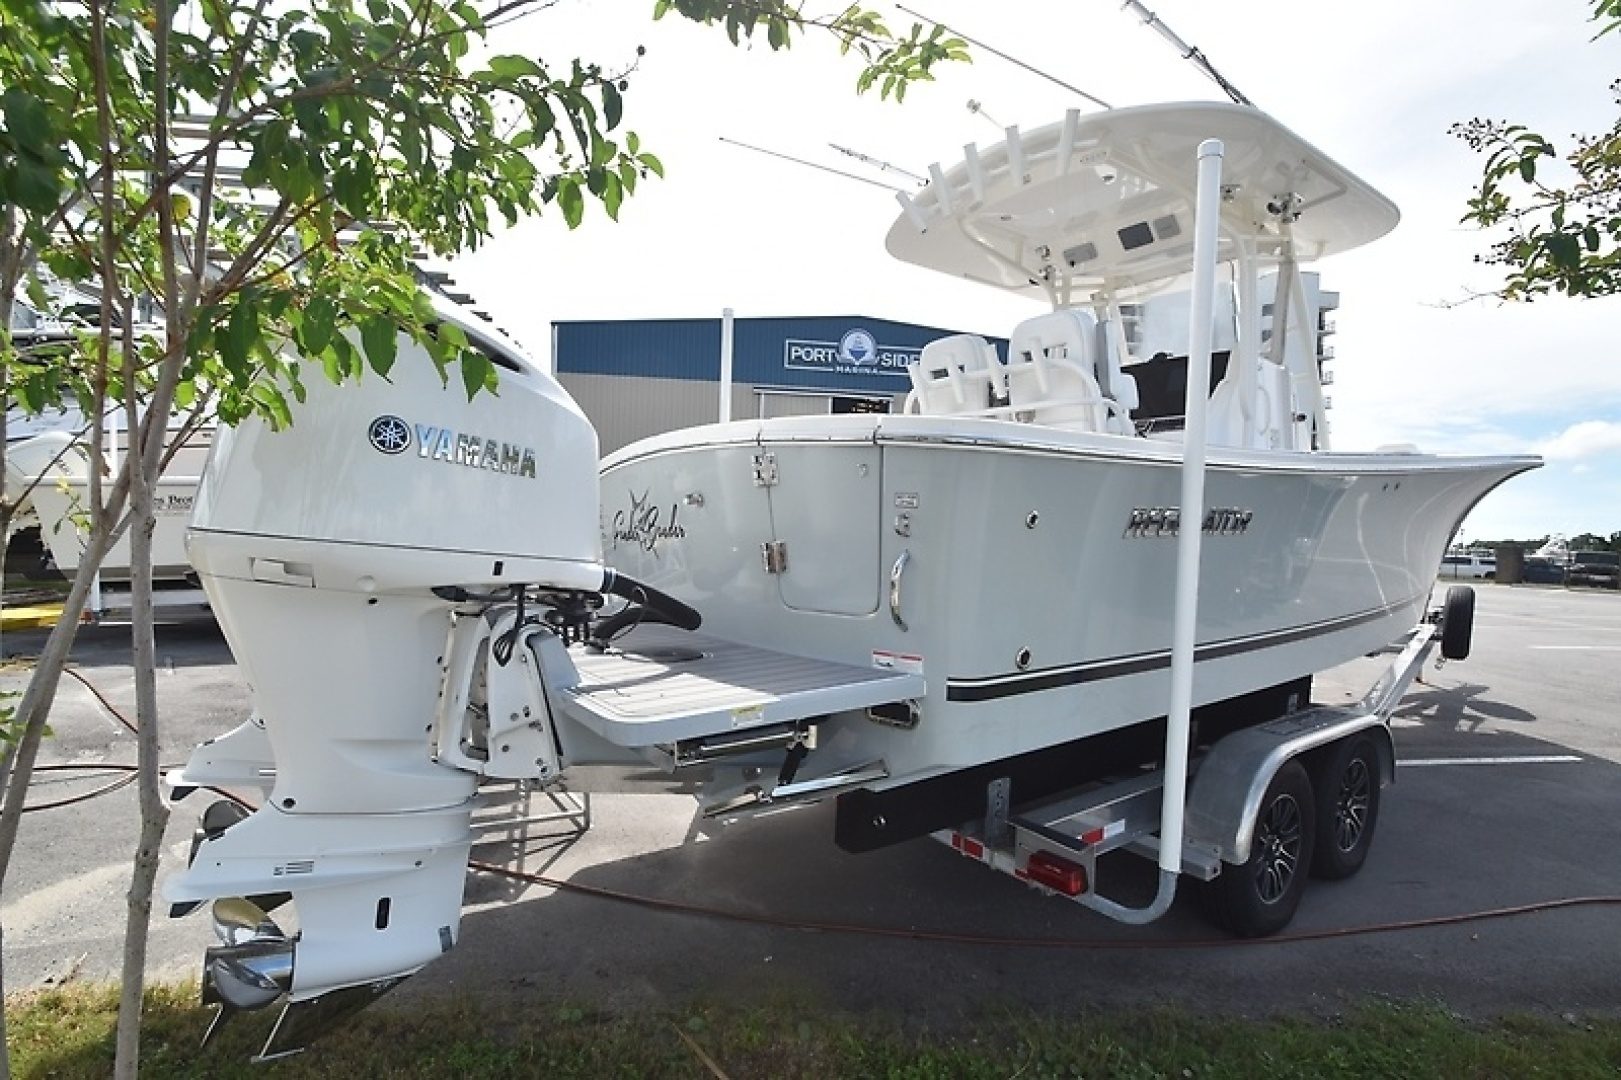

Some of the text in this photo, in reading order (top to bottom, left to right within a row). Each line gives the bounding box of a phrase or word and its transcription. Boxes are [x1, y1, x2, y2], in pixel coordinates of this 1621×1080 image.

[791, 345, 836, 363] PORT
[415, 423, 536, 479] YAMAHA
[1122, 505, 1253, 539] REGATOR
